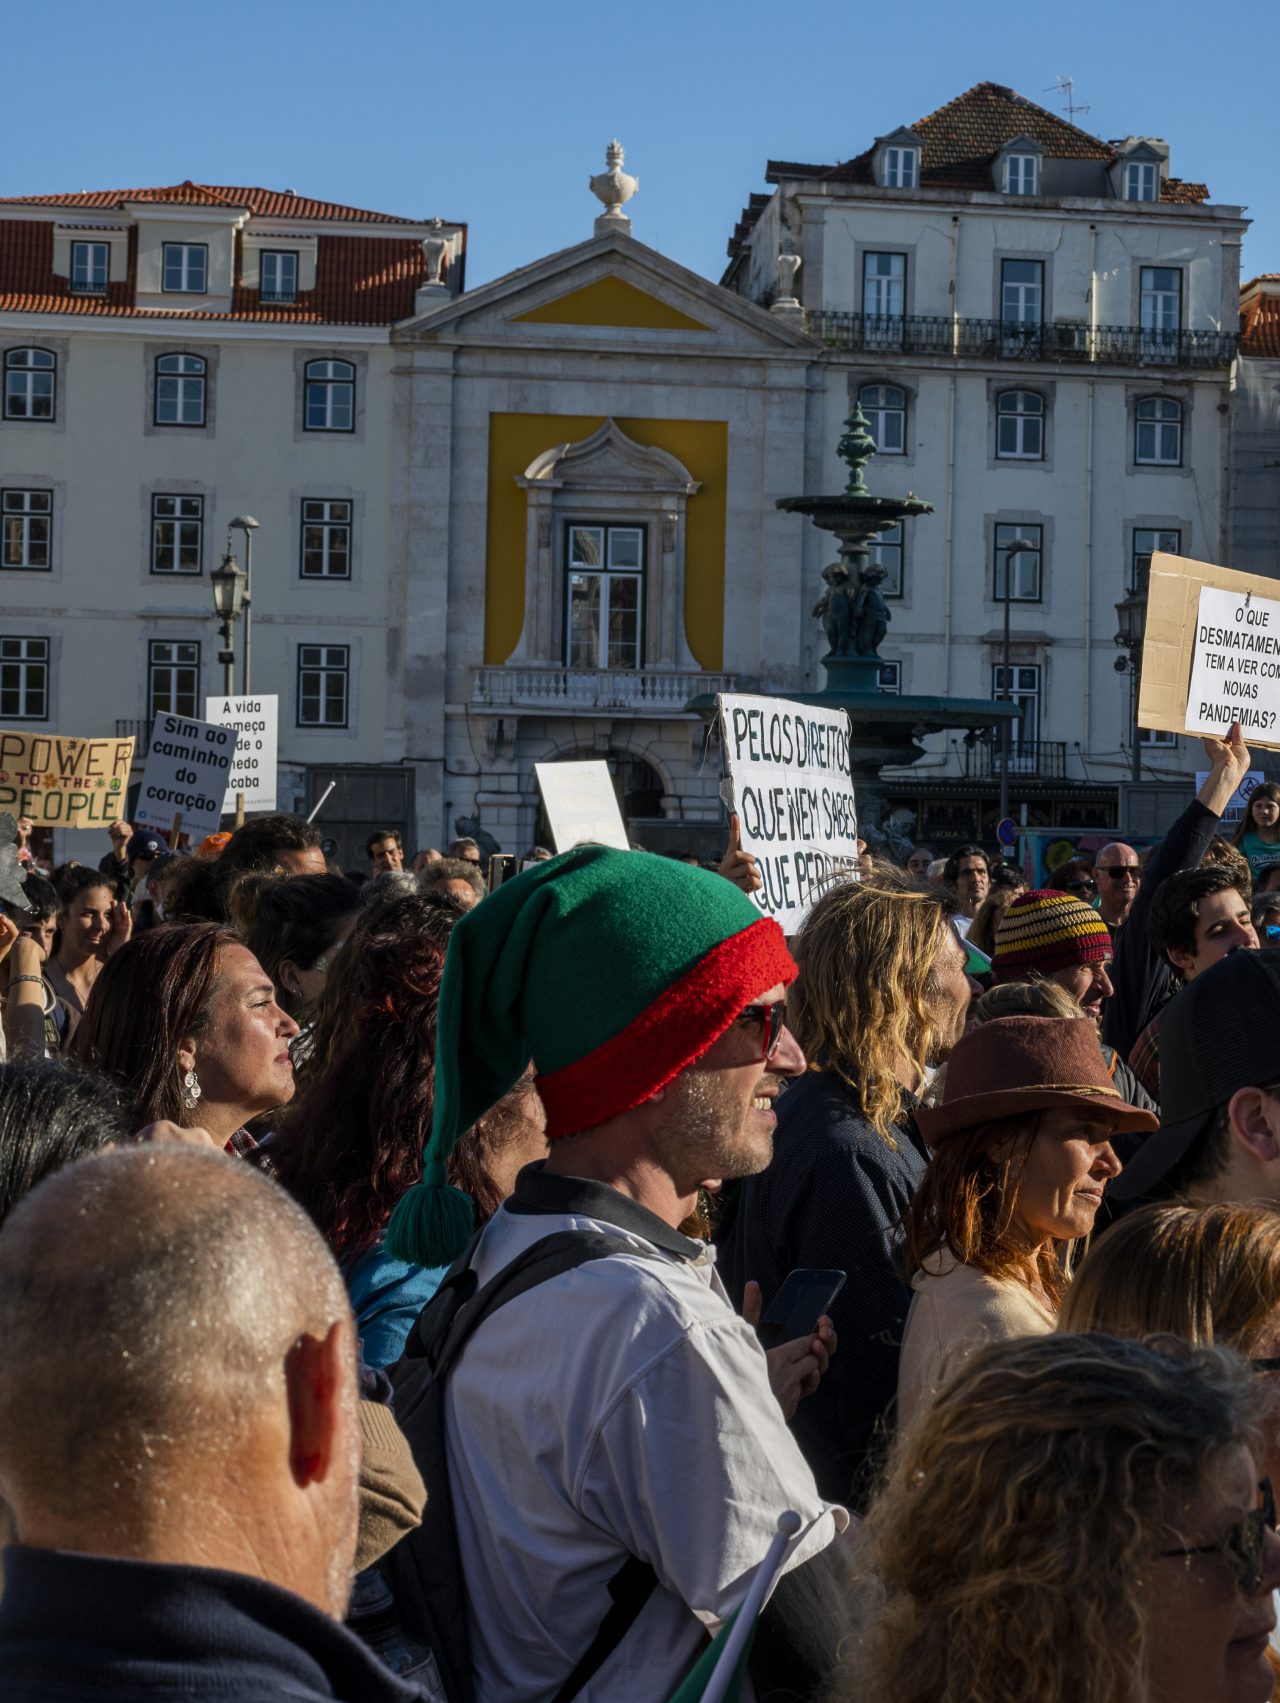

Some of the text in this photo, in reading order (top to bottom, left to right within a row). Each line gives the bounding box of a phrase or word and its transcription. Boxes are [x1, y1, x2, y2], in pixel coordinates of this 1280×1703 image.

[1235, 608, 1270, 627] O QUE
[1205, 653, 1225, 671] TEM
[1227, 659, 1235, 673] A
[1237, 660, 1257, 676] VER
[1223, 680, 1259, 699] NOVAS
[223, 701, 261, 714] A vida
[1199, 702, 1276, 730] PANDEMIAS?
[163, 717, 227, 745] Sim ao
[236, 739, 263, 750] de o
[732, 708, 851, 777] PELOS DIREITOS
[0, 735, 132, 776] POWER
[152, 740, 229, 769] caminho
[15, 772, 91, 788] TO THE
[175, 767, 197, 785] do
[0, 786, 122, 821] PEOPLE
[146, 786, 217, 812] coração
[742, 786, 857, 842] QUE NEM SABES
[753, 855, 795, 915] QUE
